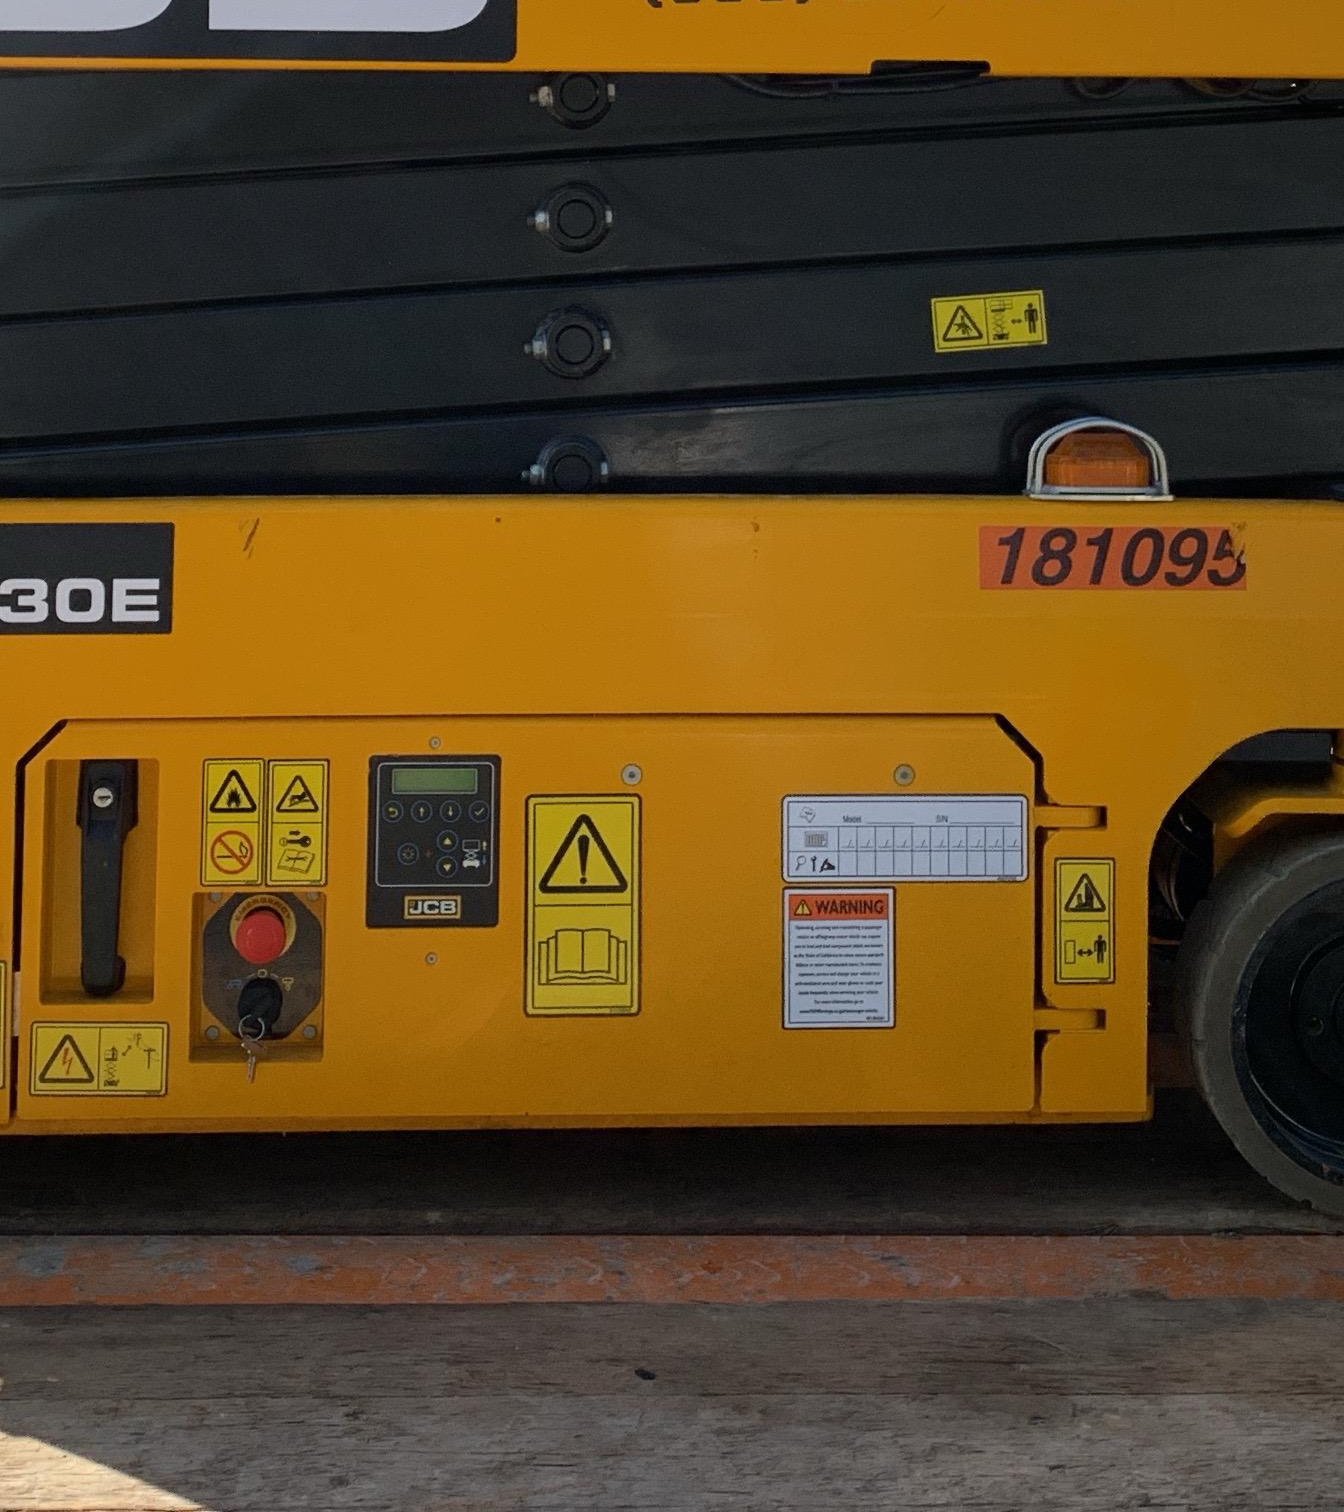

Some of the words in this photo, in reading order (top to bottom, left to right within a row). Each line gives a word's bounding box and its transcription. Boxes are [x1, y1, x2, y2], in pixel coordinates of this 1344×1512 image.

[997, 526, 1248, 588] 181095
[408, 900, 457, 915] JCB
[815, 899, 884, 915] WARNING
